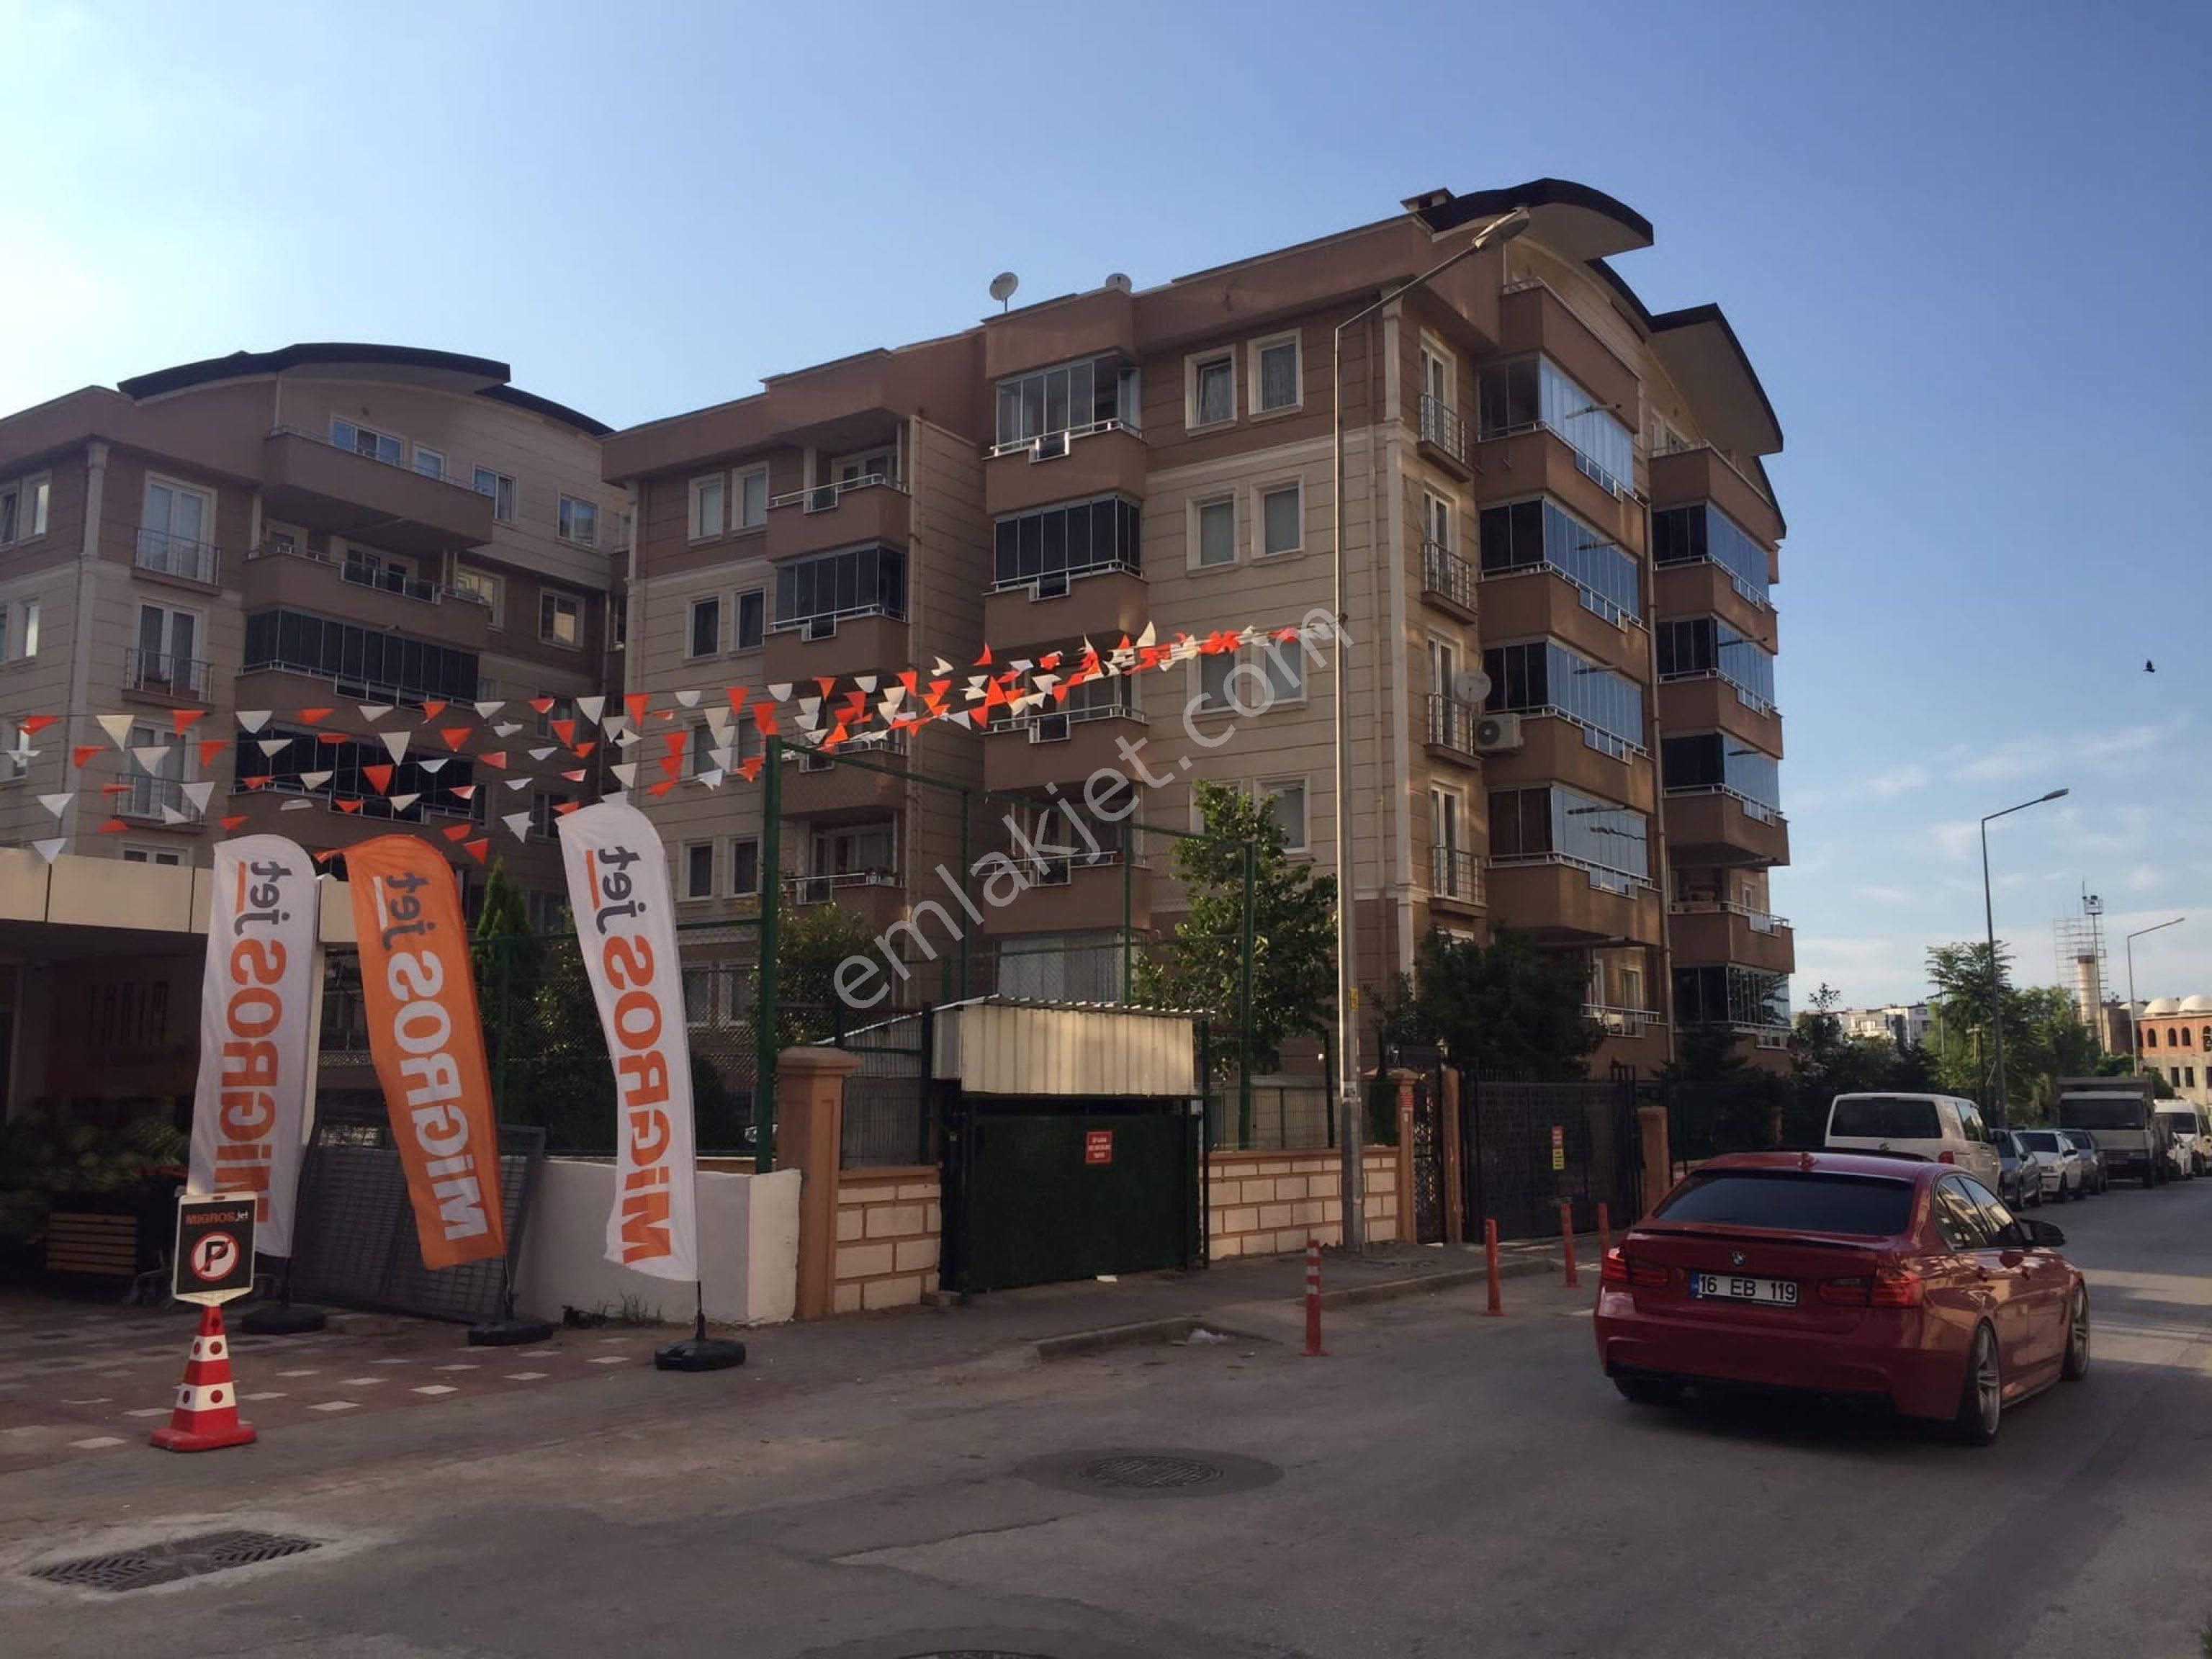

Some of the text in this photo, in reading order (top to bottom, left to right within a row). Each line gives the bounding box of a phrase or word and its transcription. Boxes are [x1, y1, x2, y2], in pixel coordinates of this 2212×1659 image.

[1701, 1276, 1796, 1300] 16 EB 119
